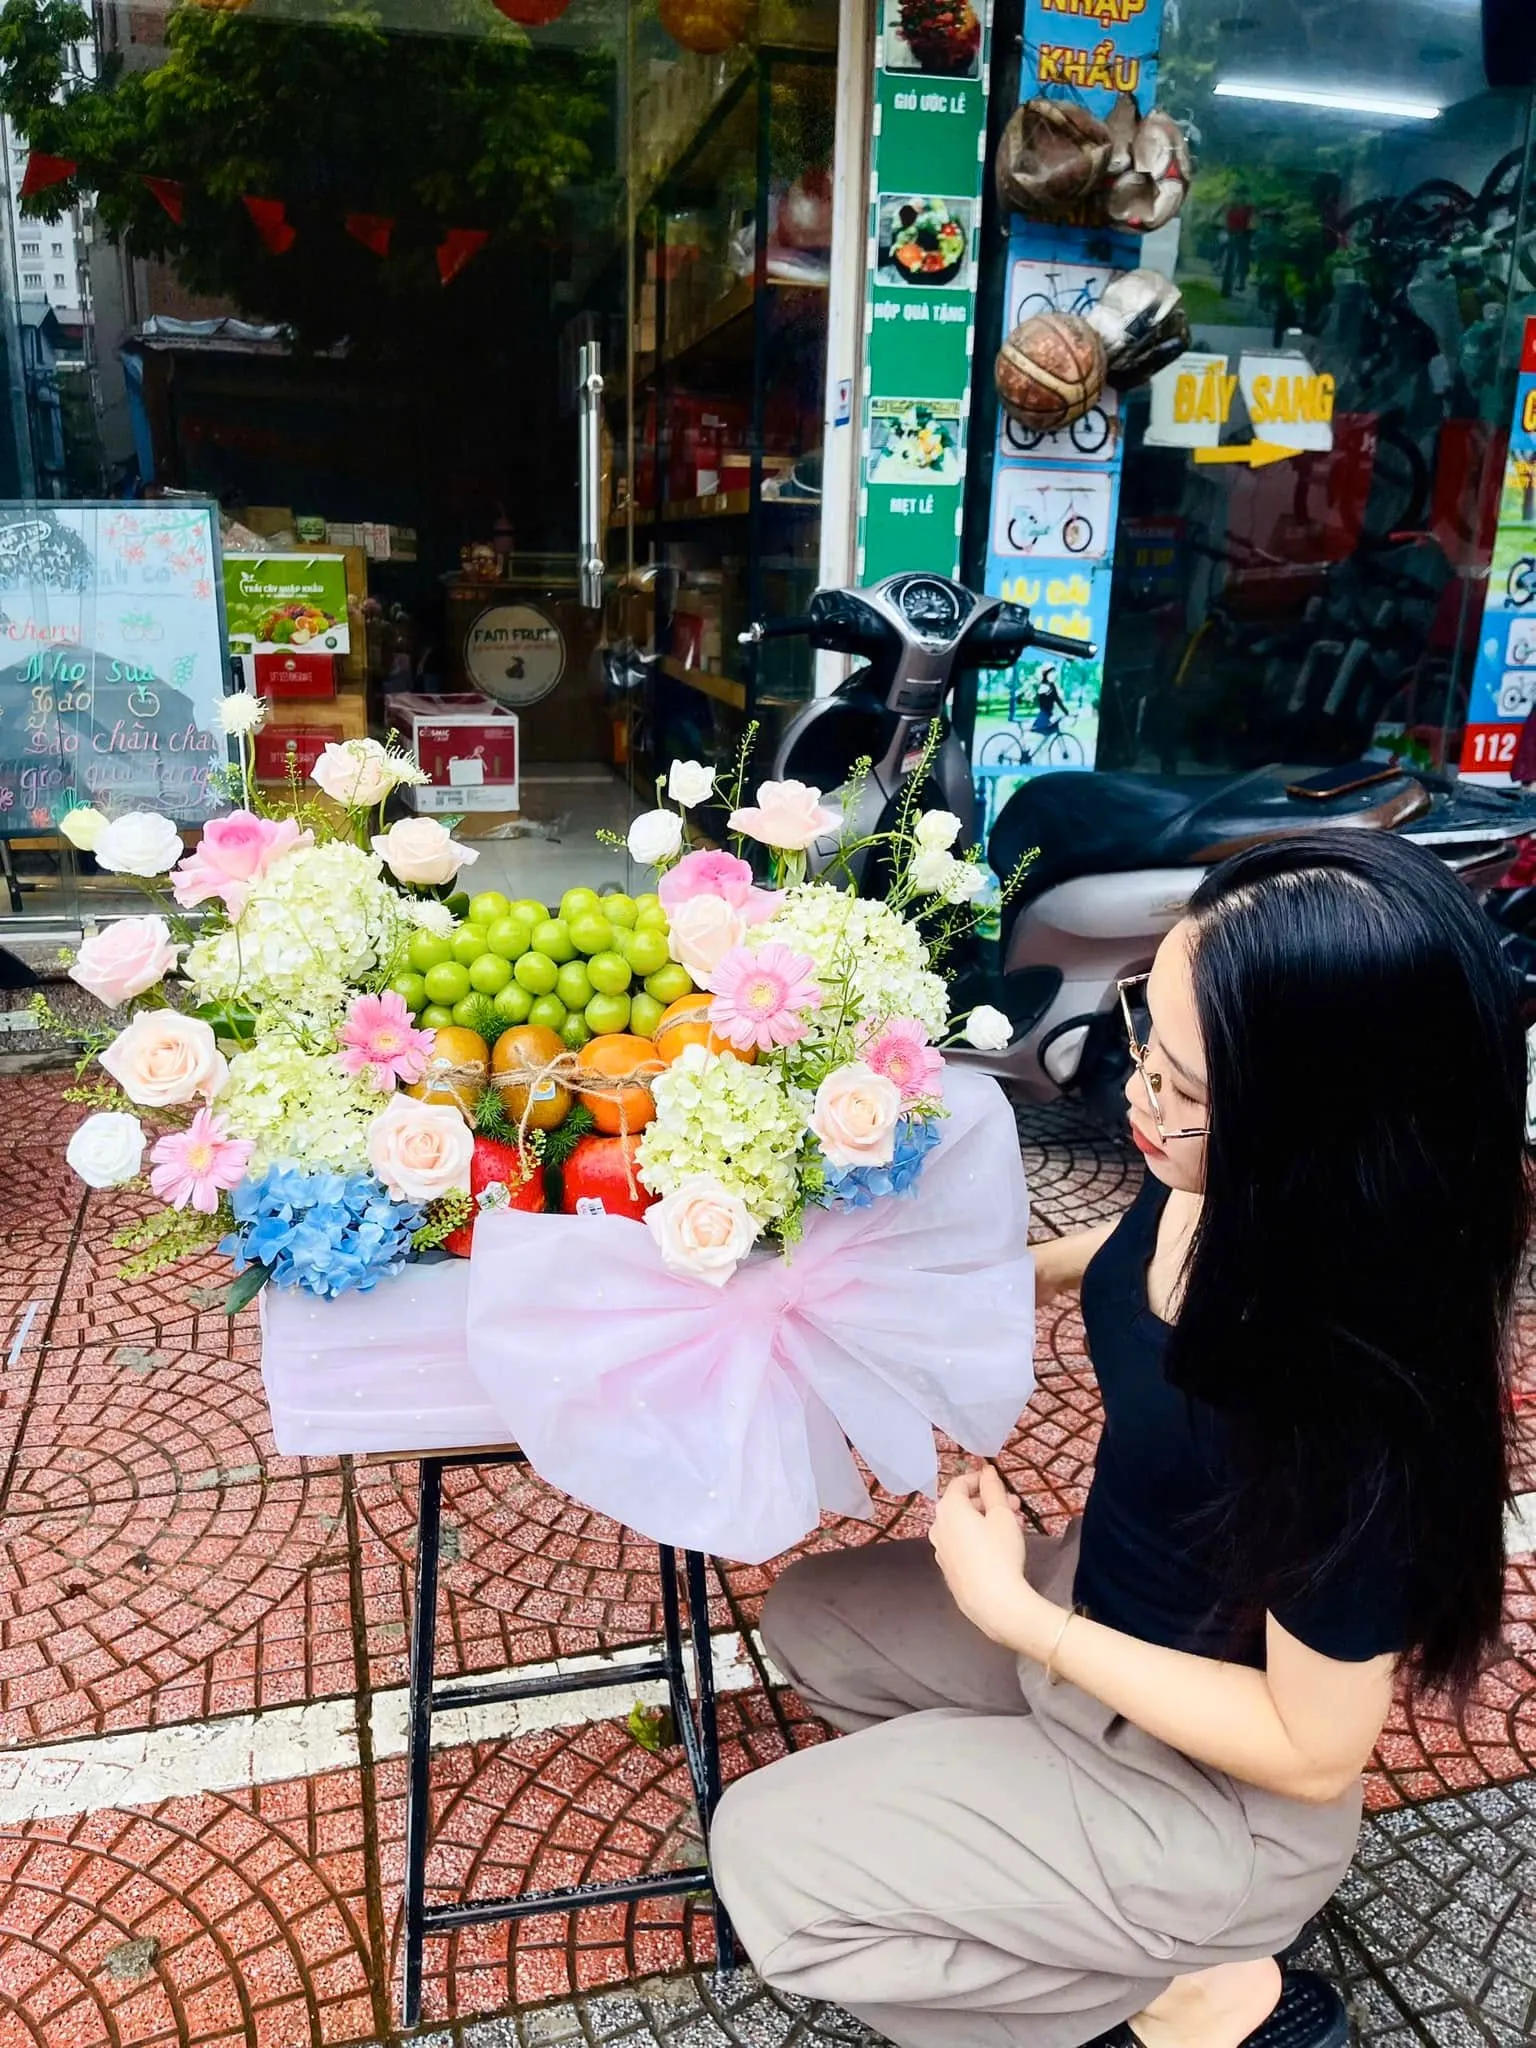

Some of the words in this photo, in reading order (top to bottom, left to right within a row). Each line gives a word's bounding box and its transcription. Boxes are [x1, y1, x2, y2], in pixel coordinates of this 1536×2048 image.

[1038, 39, 1140, 93] KHẨU
[1250, 372, 1336, 424] SANG
[1473, 732, 1517, 763] 112
